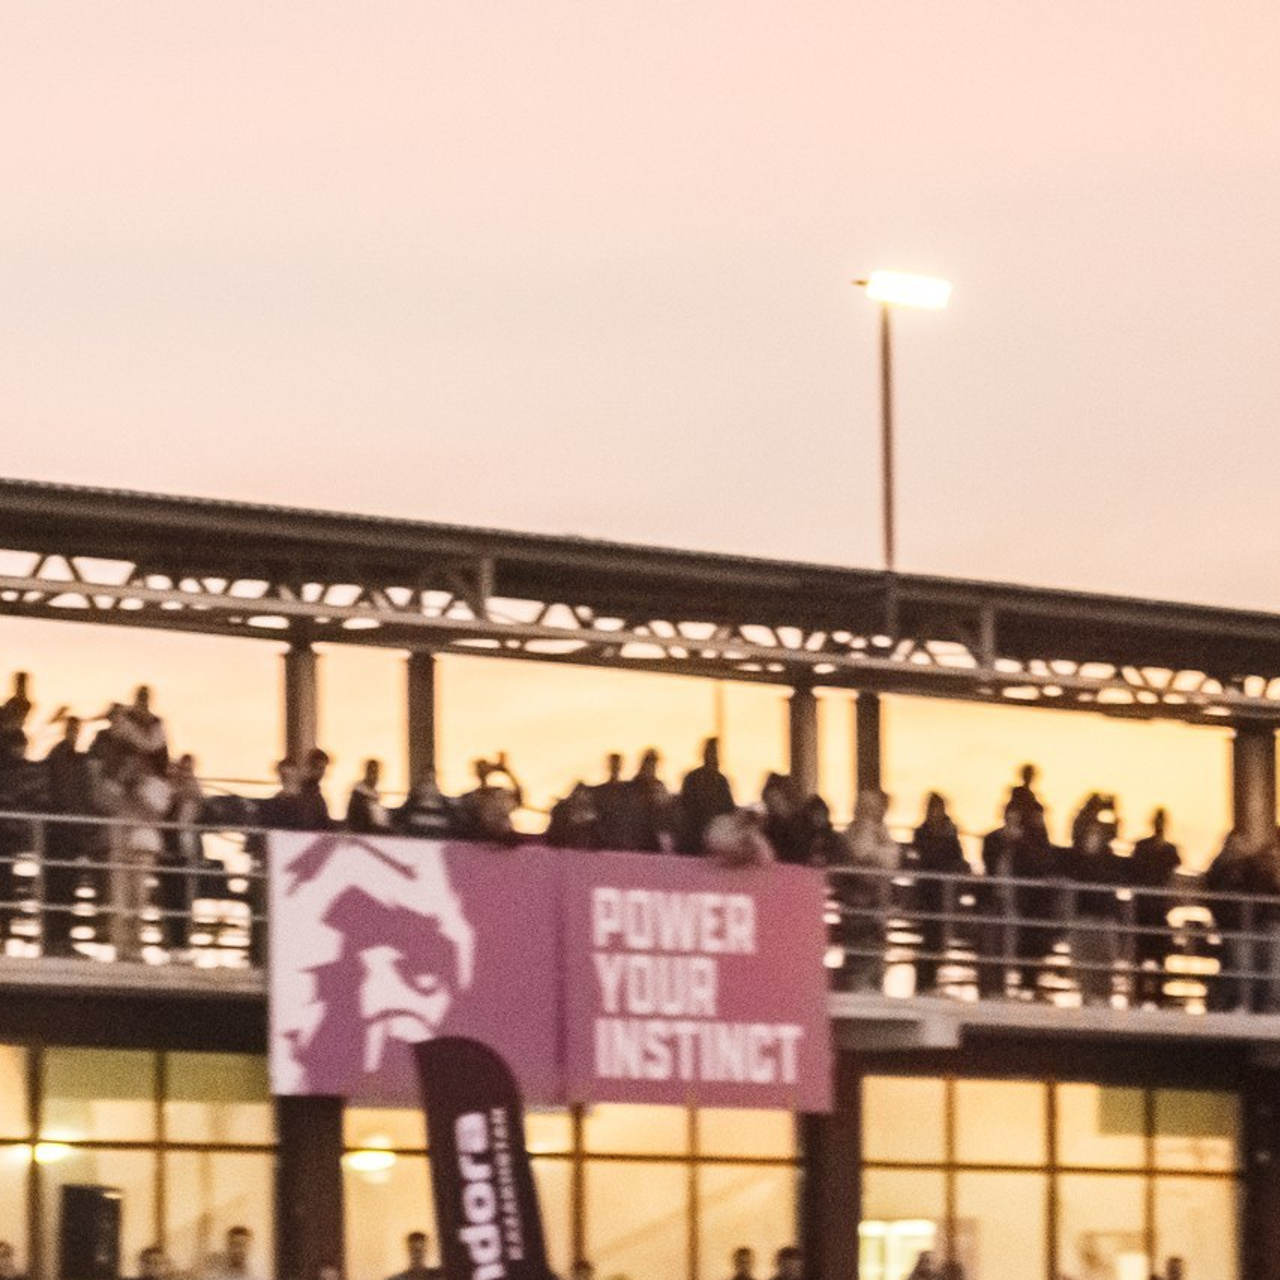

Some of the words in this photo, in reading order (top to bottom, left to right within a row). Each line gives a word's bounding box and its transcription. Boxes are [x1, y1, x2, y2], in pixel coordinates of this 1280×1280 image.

[593, 886, 756, 954] POWER
[594, 953, 717, 1016] YOUR
[595, 1018, 805, 1084] INSTINCT
